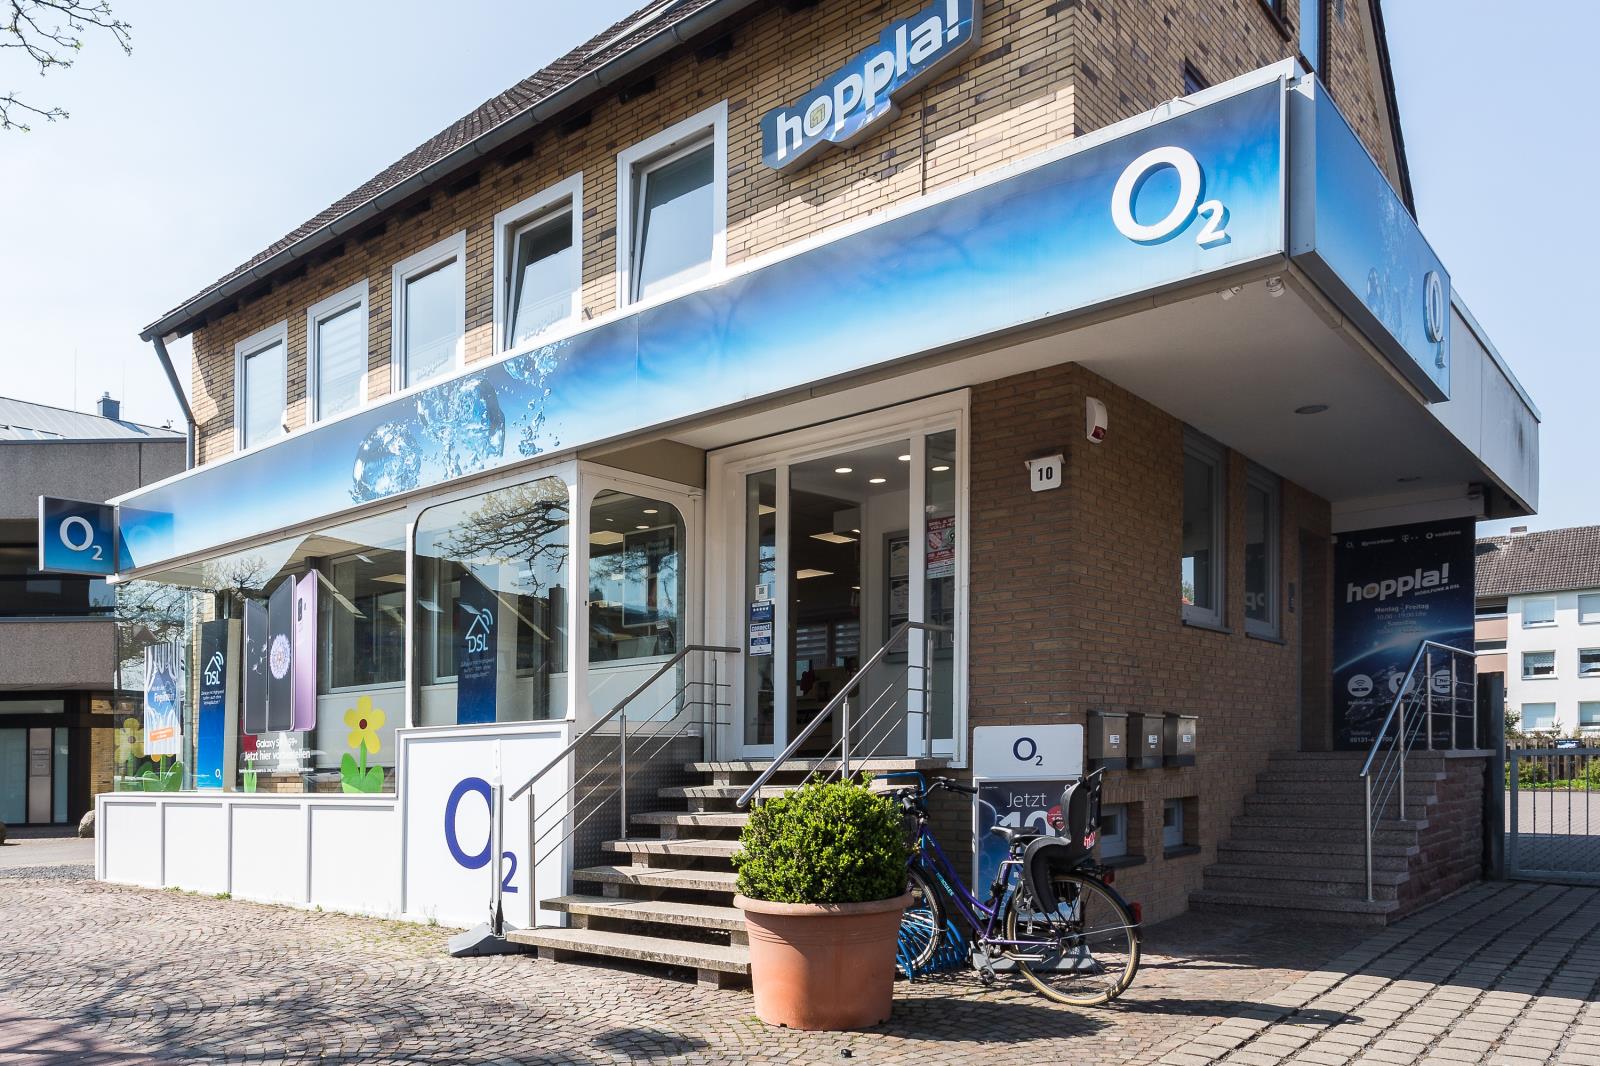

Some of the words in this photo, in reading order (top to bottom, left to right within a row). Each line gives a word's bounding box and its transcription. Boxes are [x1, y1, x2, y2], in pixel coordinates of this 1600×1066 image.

[776, 0, 961, 162] hoppla!
[1111, 146, 1229, 249] O2
[1037, 466, 1054, 482] 10
[58, 515, 104, 562] O2
[1346, 562, 1450, 603] hoppla!
[468, 633, 489, 654] DSL
[205, 670, 221, 686] DSL
[255, 739, 276, 749] Galaxy
[259, 749, 272, 760] hier
[1013, 736, 1043, 767] O2
[1006, 791, 1048, 808] Jetzt
[444, 776, 519, 894] O2
